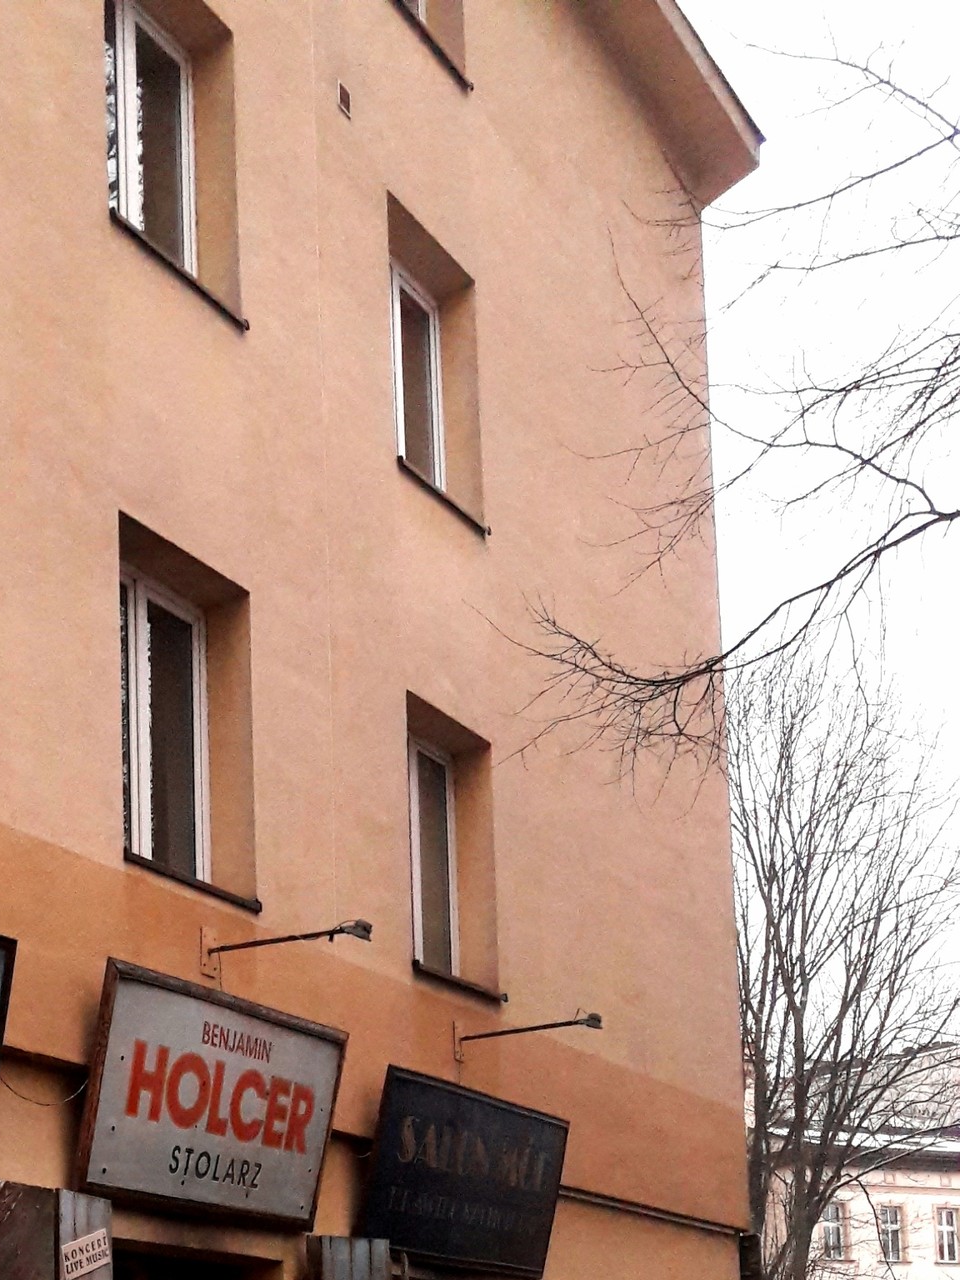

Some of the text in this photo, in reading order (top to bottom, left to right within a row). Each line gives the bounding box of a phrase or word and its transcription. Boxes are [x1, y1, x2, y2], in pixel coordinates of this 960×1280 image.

[201, 1020, 273, 1064] BENJAMIN
[125, 1037, 316, 1155] HOLCER
[168, 1145, 262, 1190] STOLARZ
[65, 1259, 84, 1275] LIVE
